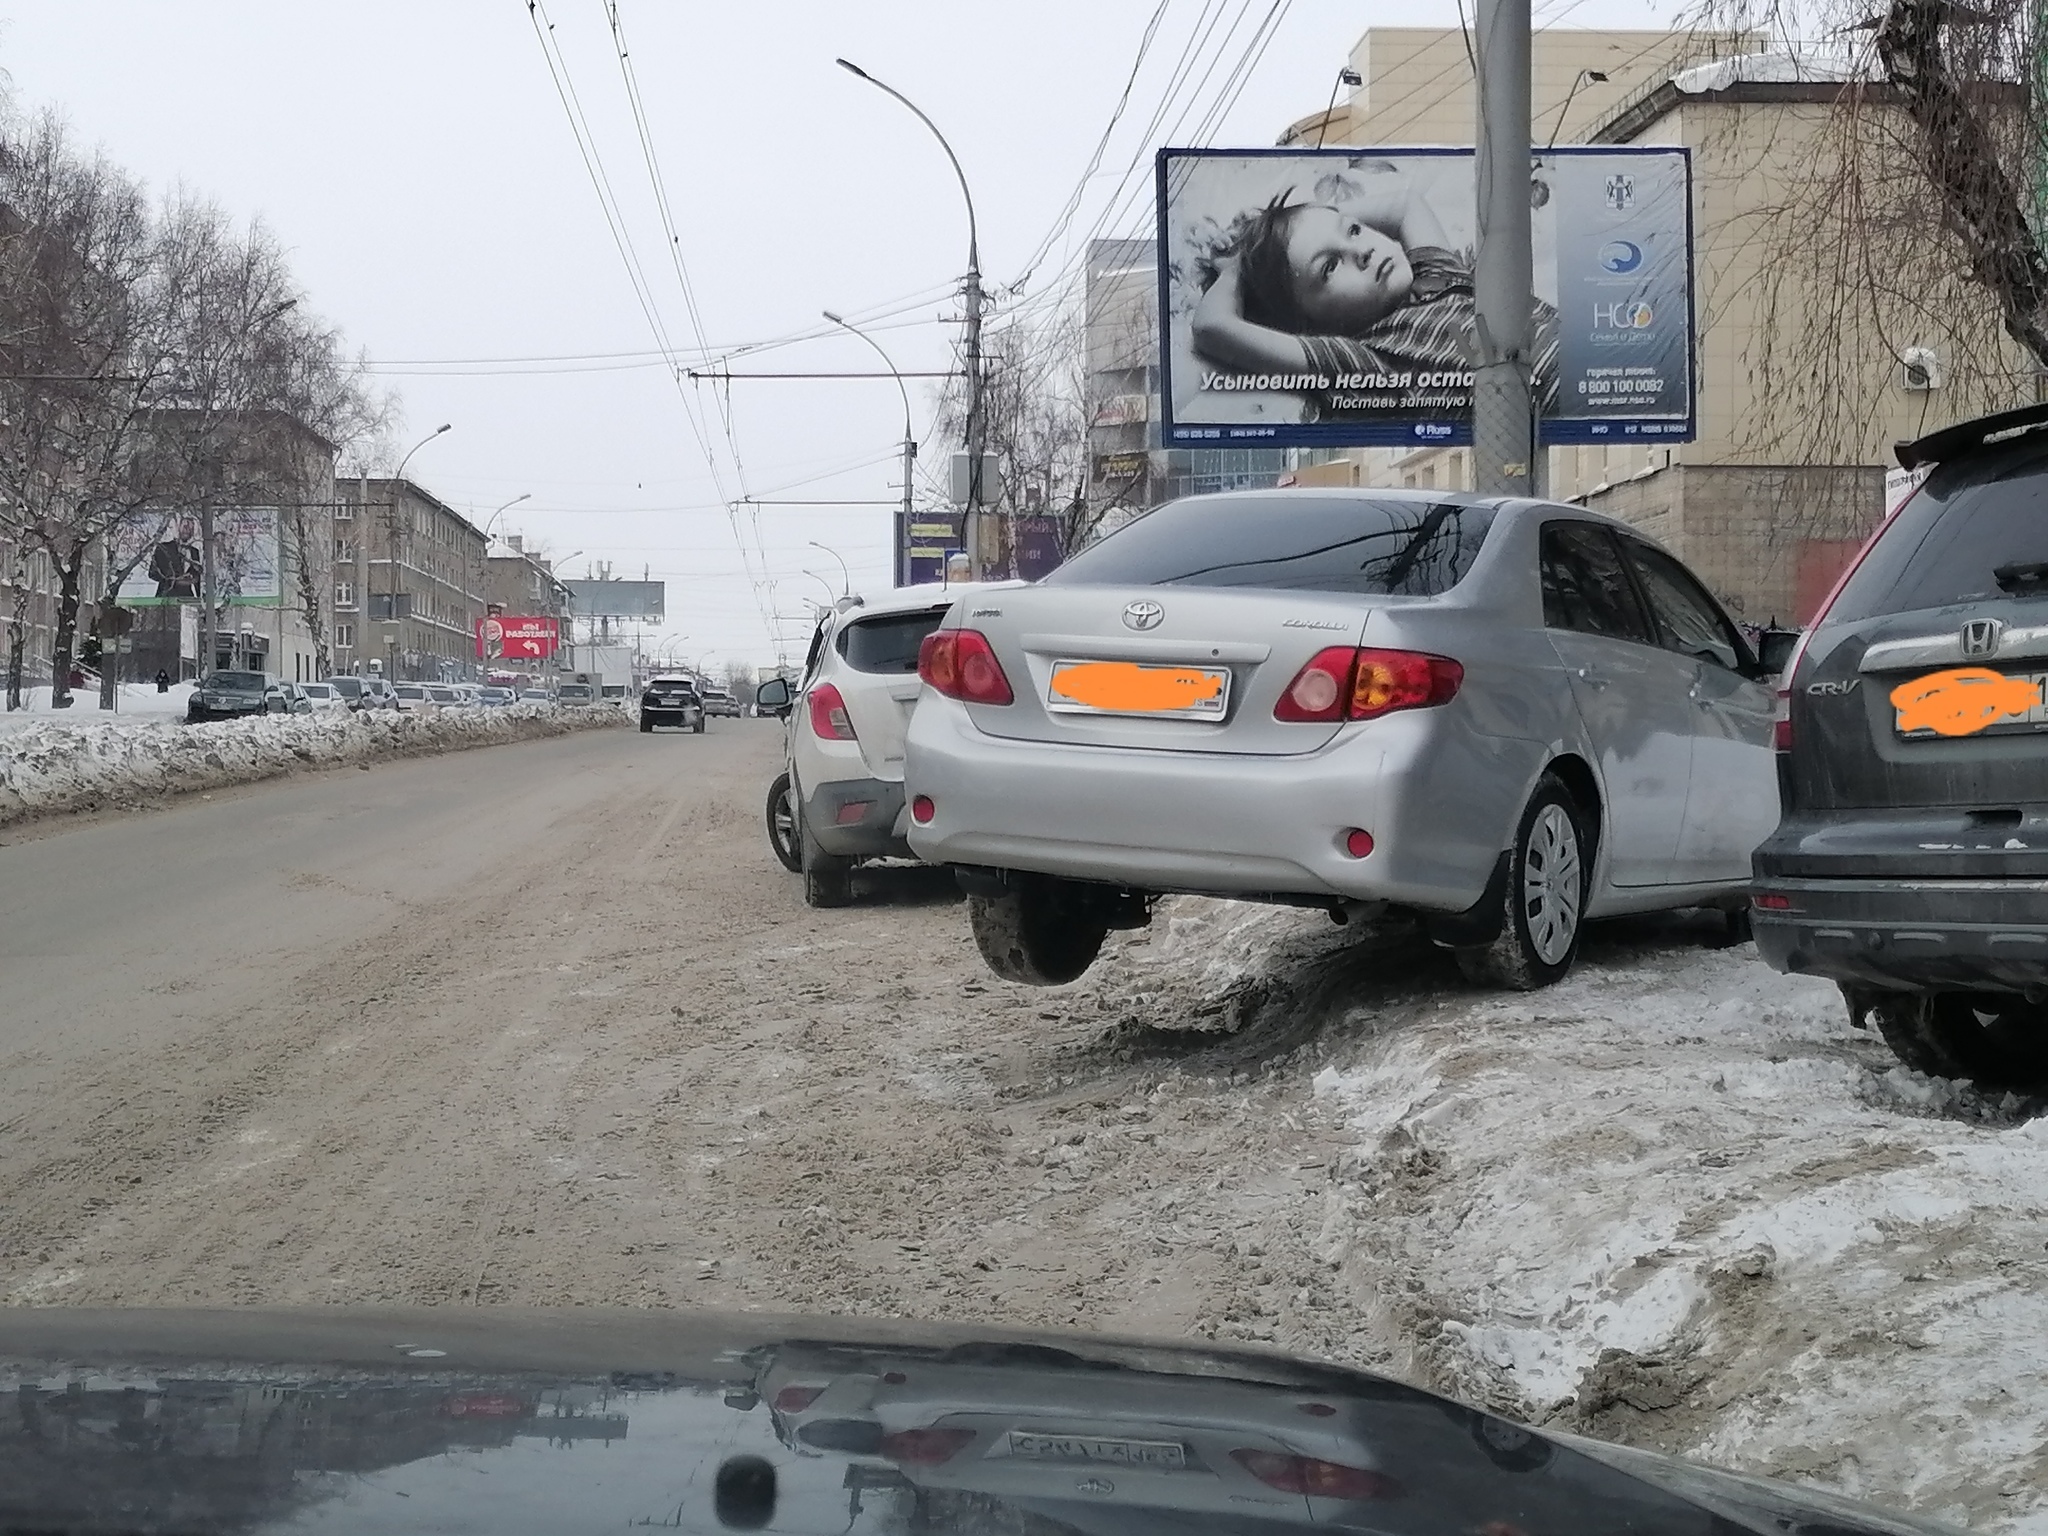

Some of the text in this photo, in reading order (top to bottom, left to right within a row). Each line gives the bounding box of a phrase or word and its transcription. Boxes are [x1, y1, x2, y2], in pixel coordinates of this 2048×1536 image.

[1200, 371, 1330, 391] Усыновить
[1335, 371, 1412, 389] нельзя
[1588, 380, 1611, 393] 800
[1612, 380, 1634, 392] 100
[1332, 395, 1396, 410] Поставь
[1400, 395, 1466, 411] запятую
[1807, 679, 1861, 697] CR-V
